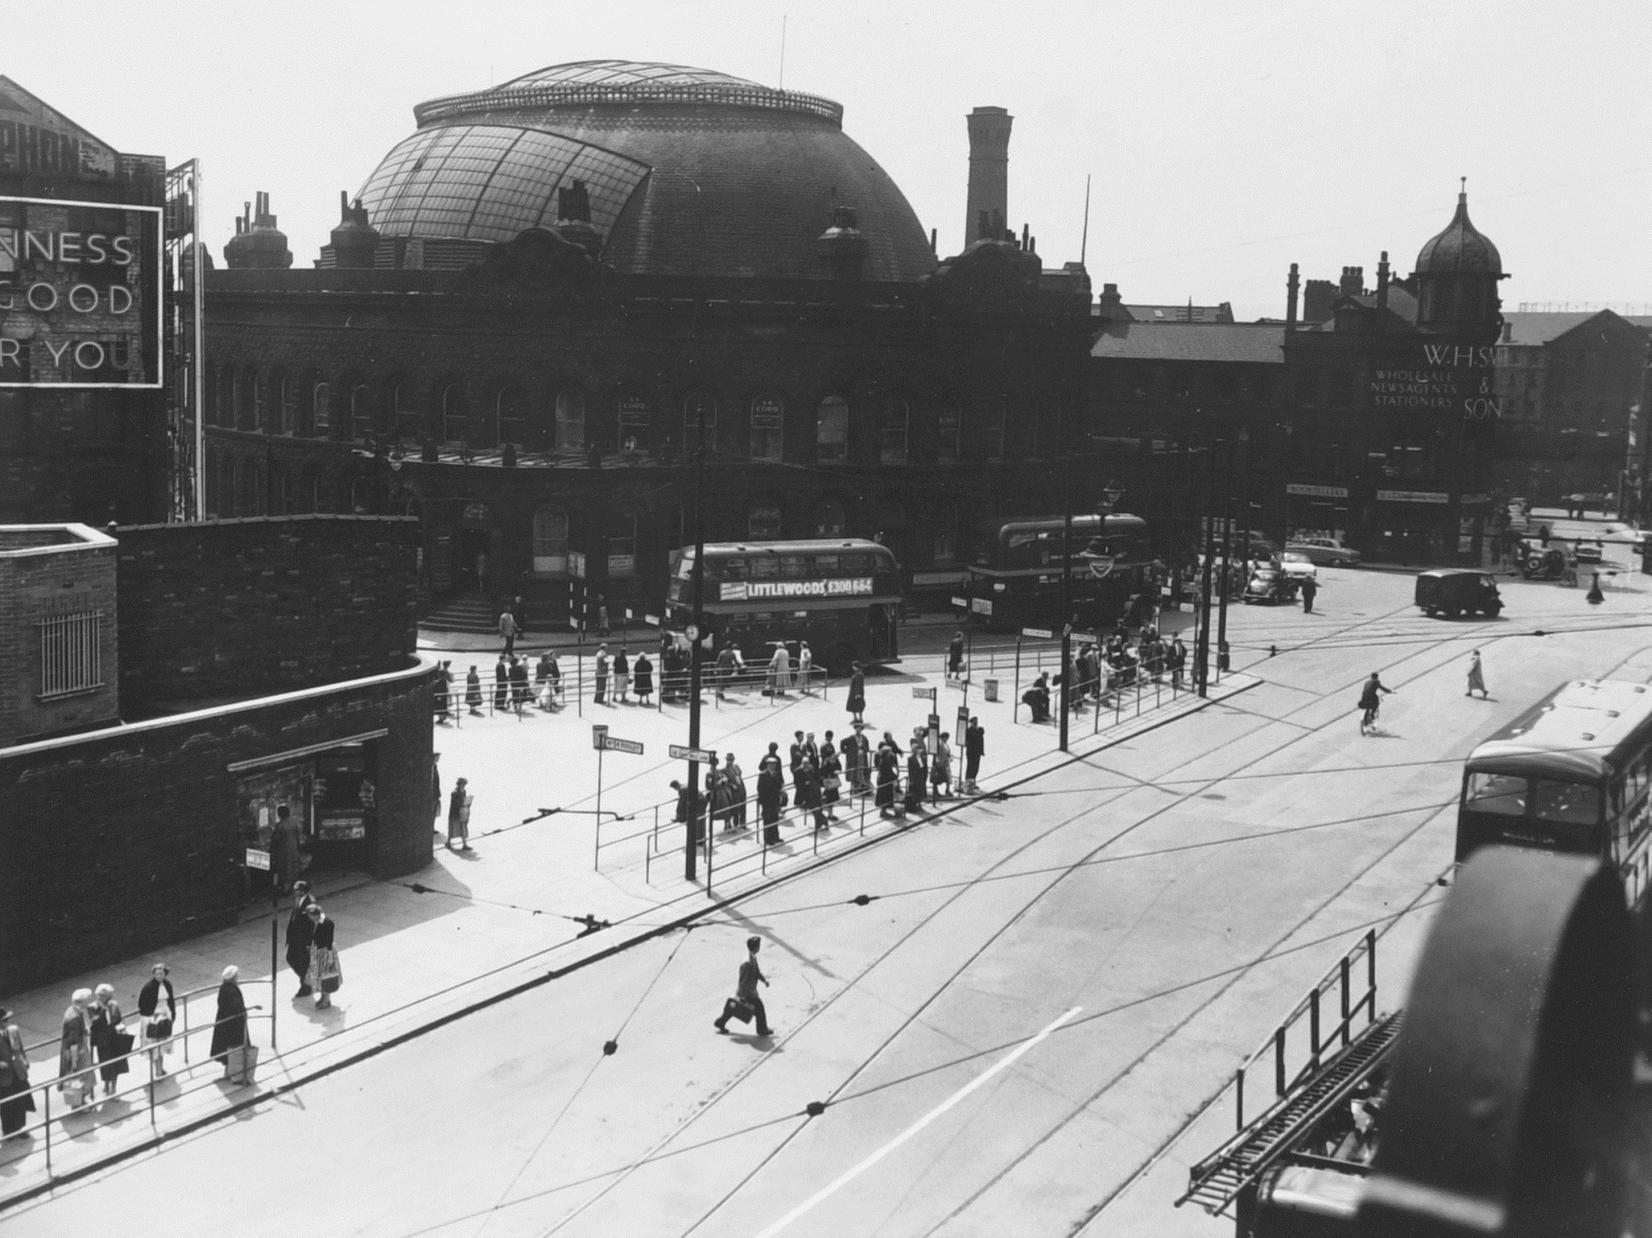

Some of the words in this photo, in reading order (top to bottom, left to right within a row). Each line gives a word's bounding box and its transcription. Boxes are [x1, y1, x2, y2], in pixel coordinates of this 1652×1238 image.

[45, 340, 130, 370] YOU
[1369, 382, 1457, 394] NEWSAGENTS
[1479, 376, 1489, 394] &
[1463, 398, 1504, 420] SON
